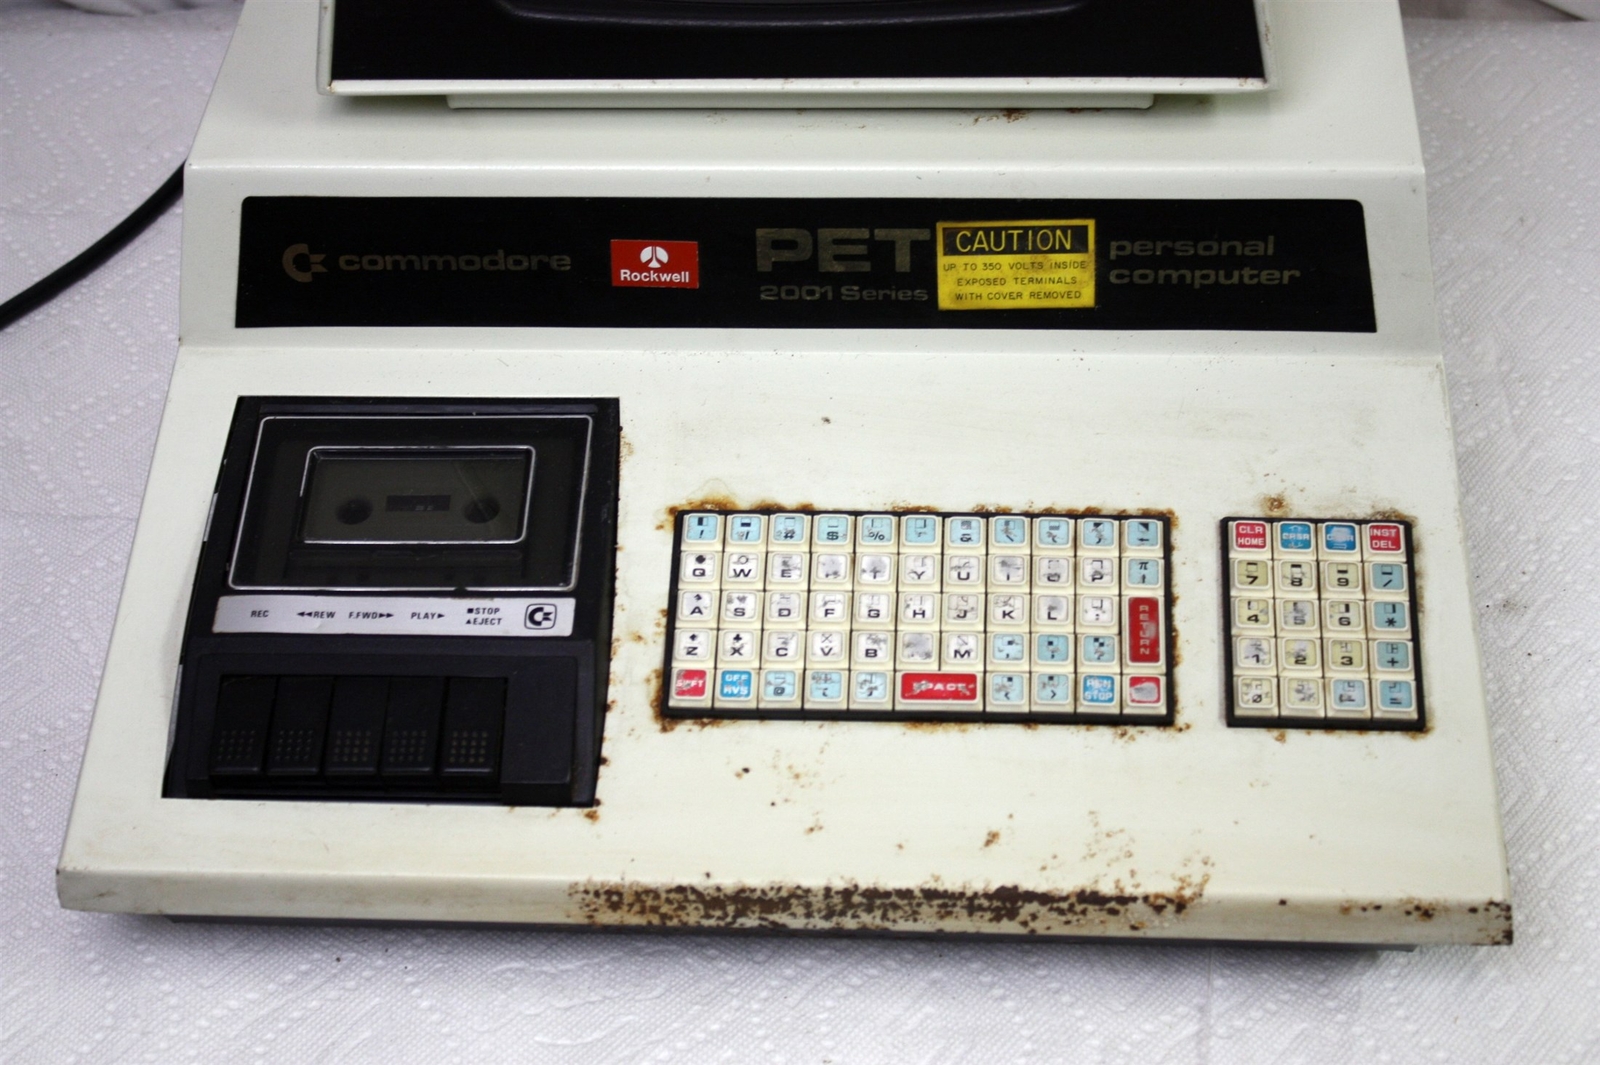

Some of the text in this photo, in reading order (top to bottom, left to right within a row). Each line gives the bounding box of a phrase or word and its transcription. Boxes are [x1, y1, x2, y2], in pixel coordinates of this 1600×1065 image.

[956, 229, 1072, 252] CAUTION
[756, 228, 931, 272] PET
[1110, 235, 1275, 260] personal
[339, 249, 572, 272] commodore
[943, 261, 1087, 272] UP TO 350 VOLTS INSIDE
[620, 269, 689, 283] Rockwell
[1110, 268, 1301, 288] computer
[957, 276, 1077, 286] EXPOSED TERMINALS
[760, 285, 929, 300] 2001 Series
[955, 290, 1082, 301] WITH COVER REMOVED
[1239, 525, 1263, 534] CLR
[1370, 528, 1397, 537] INST
[1238, 538, 1265, 546] HOME
[1372, 540, 1396, 548] DEL
[692, 568, 706, 578] Q
[733, 568, 752, 578] W
[781, 568, 792, 578] E
[912, 571, 925, 580] Y
[957, 571, 970, 580] U
[1246, 575, 1258, 585] 7
[1337, 577, 1349, 587] 9
[250, 610, 269, 618] REC
[313, 611, 336, 619] REW
[690, 606, 703, 615] A
[734, 608, 746, 617] S
[778, 608, 791, 617] D
[824, 609, 835, 617] F
[868, 609, 880, 618] G
[912, 609, 925, 618] H
[956, 610, 968, 619] J
[1002, 610, 1014, 619] K
[348, 612, 378, 620] F.FWD
[411, 612, 436, 620] PLAY
[1047, 611, 1057, 620] L
[1247, 614, 1259, 623] 4
[472, 618, 502, 626] EJECT
[1338, 616, 1351, 626] 6
[686, 646, 698, 656] Z
[730, 646, 743, 656] X
[776, 647, 788, 657] C
[821, 647, 833, 656] V
[865, 648, 877, 658] B
[954, 650, 971, 658] M
[1294, 656, 1307, 664] 2
[1340, 656, 1353, 665] 3
[725, 674, 748, 682] OFF
